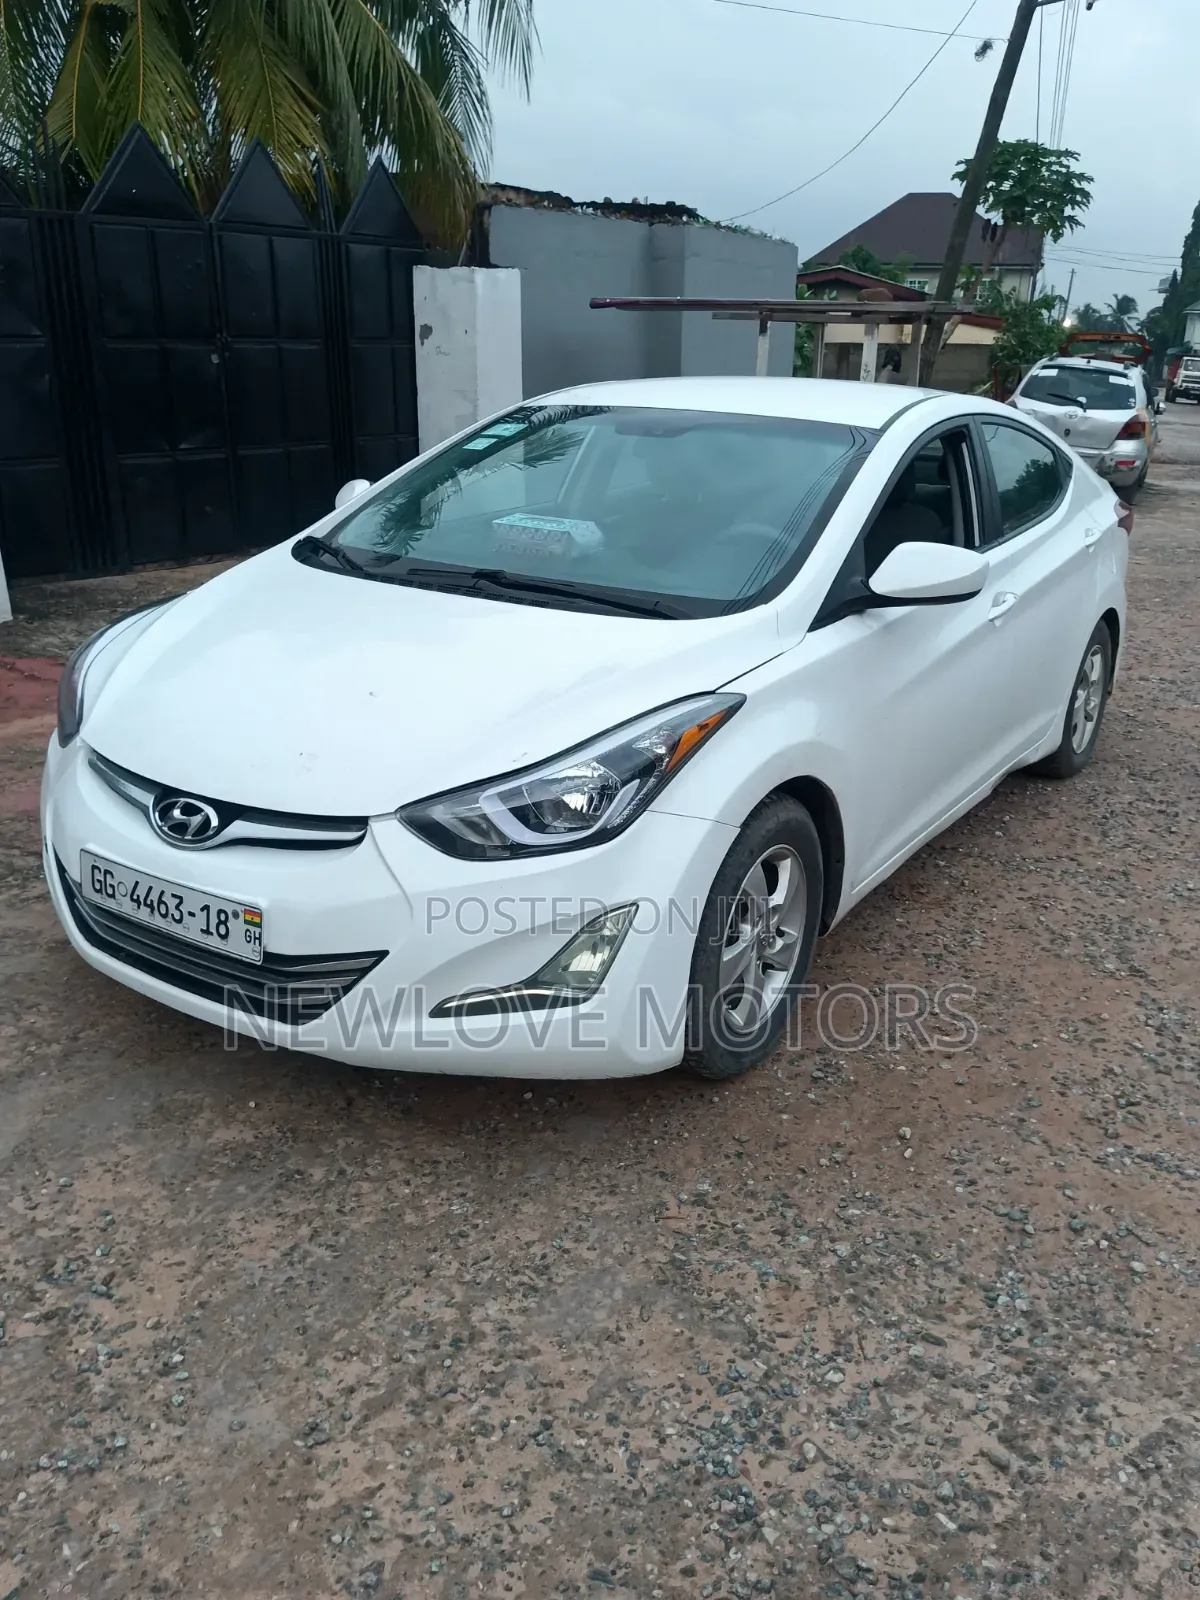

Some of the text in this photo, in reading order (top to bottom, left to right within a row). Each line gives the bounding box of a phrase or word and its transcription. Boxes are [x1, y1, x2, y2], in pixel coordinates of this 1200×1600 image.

[91, 863, 230, 941] GG 4463-18
[244, 928, 261, 947] GH
